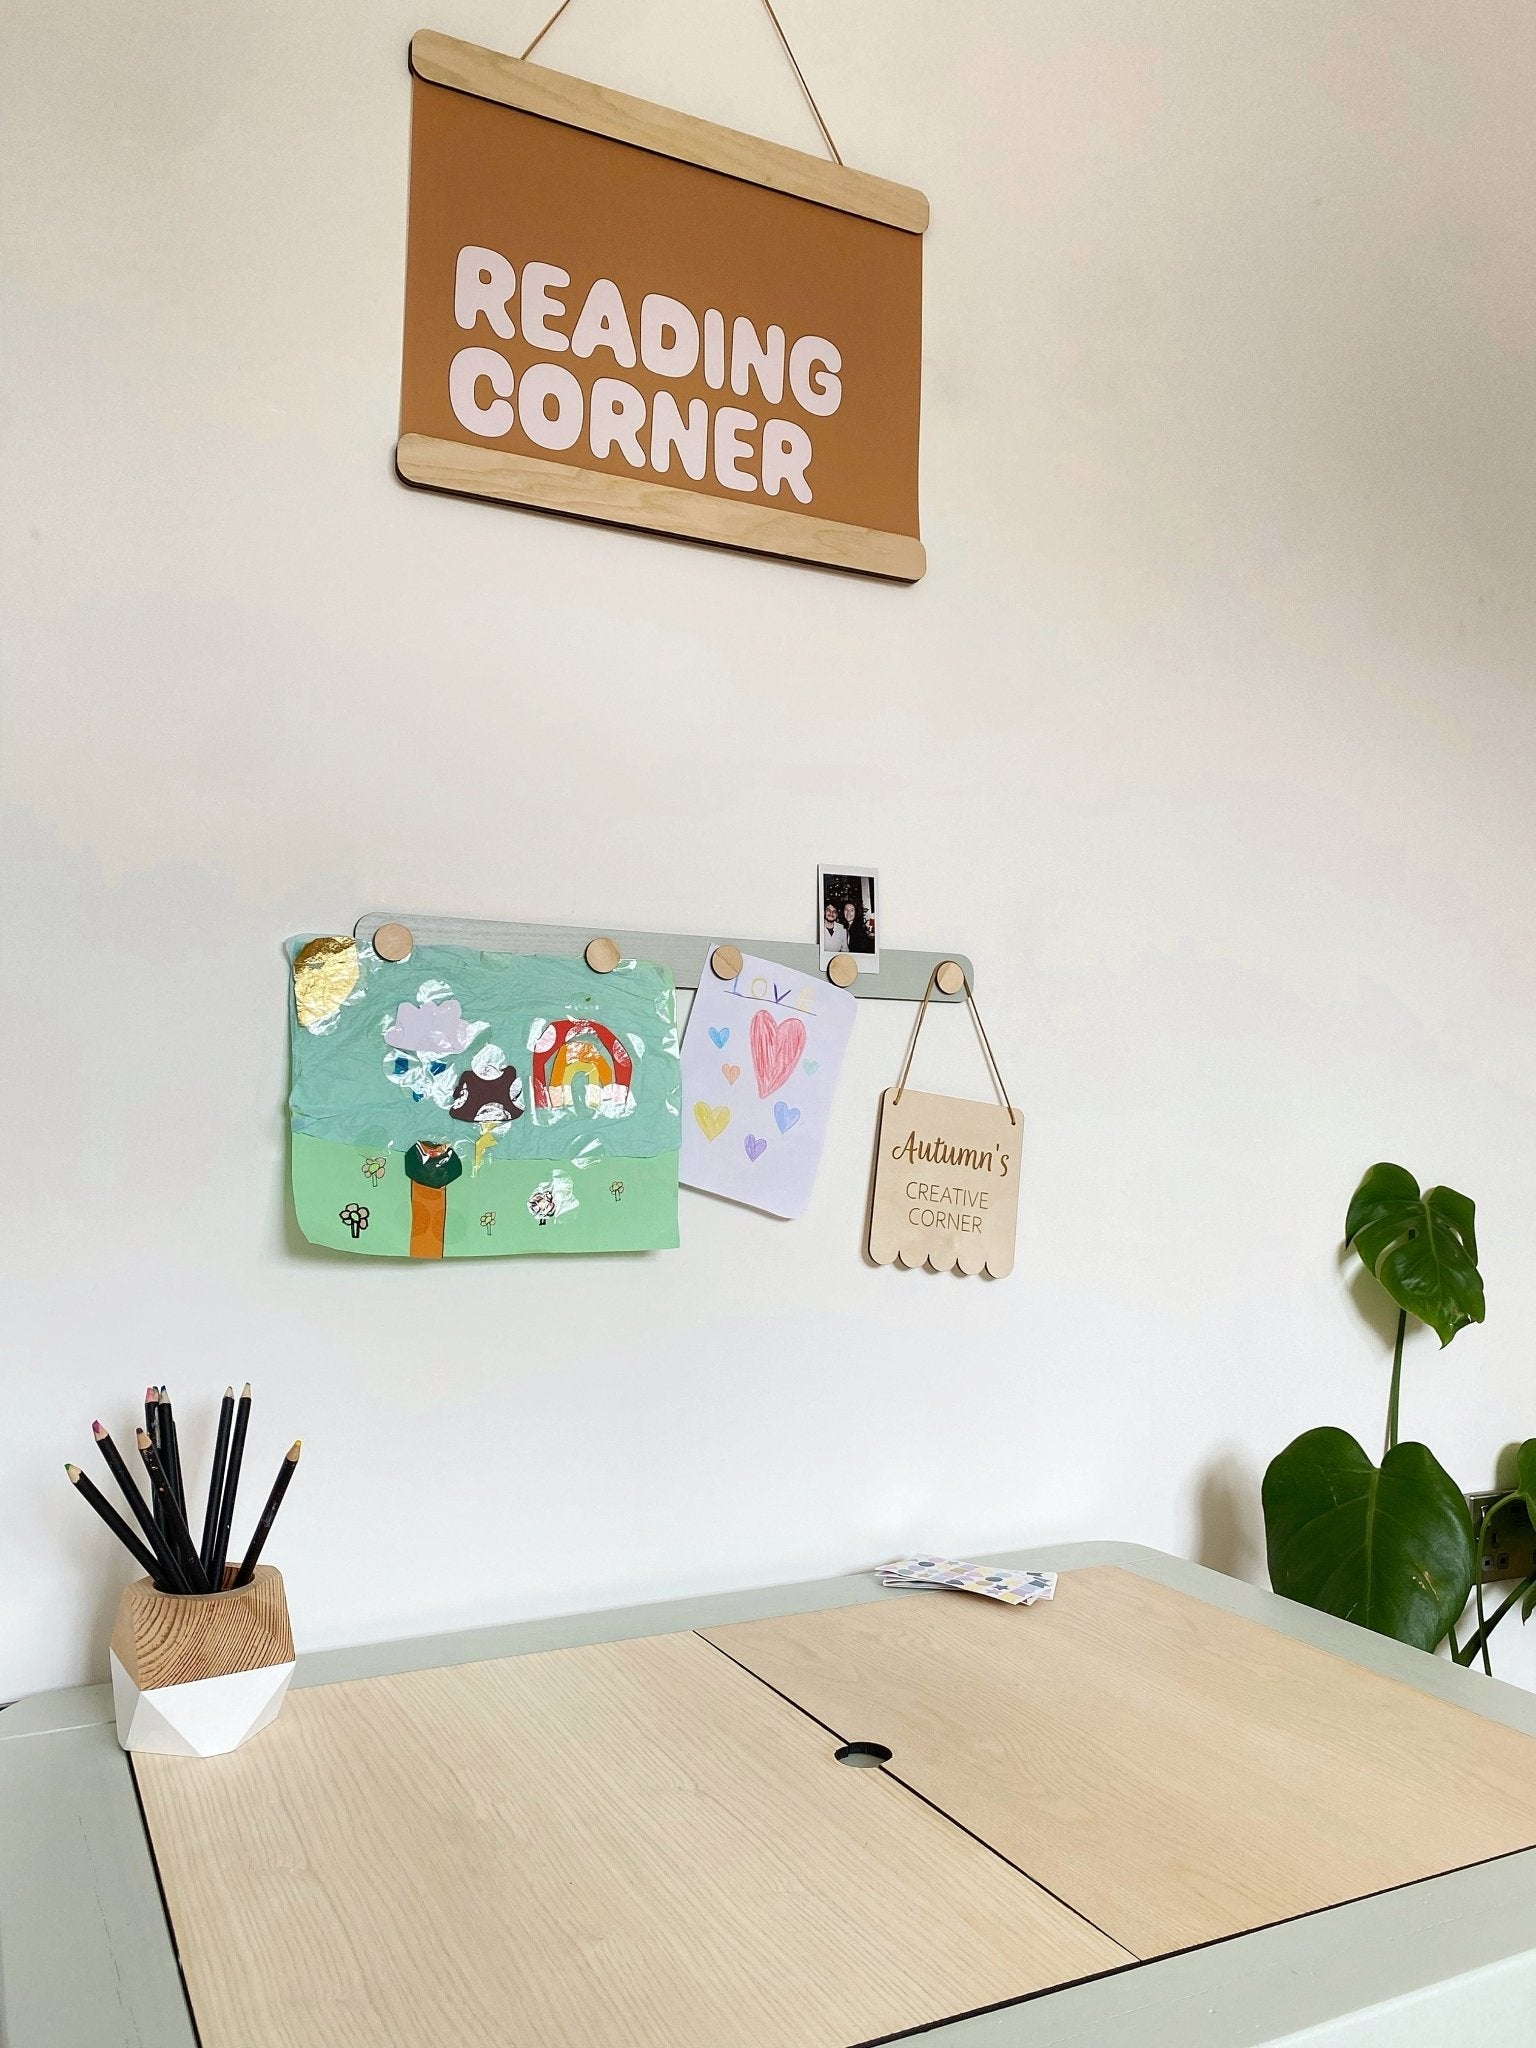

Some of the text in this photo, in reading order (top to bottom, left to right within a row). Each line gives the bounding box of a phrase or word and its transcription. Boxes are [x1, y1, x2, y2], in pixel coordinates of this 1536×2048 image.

[454, 245, 842, 417] READING
[449, 346, 814, 504] CORNER
[892, 1131, 1010, 1177] Autumn's
[906, 1181, 989, 1209] CREATIVE
[908, 1207, 983, 1234] CORNER
